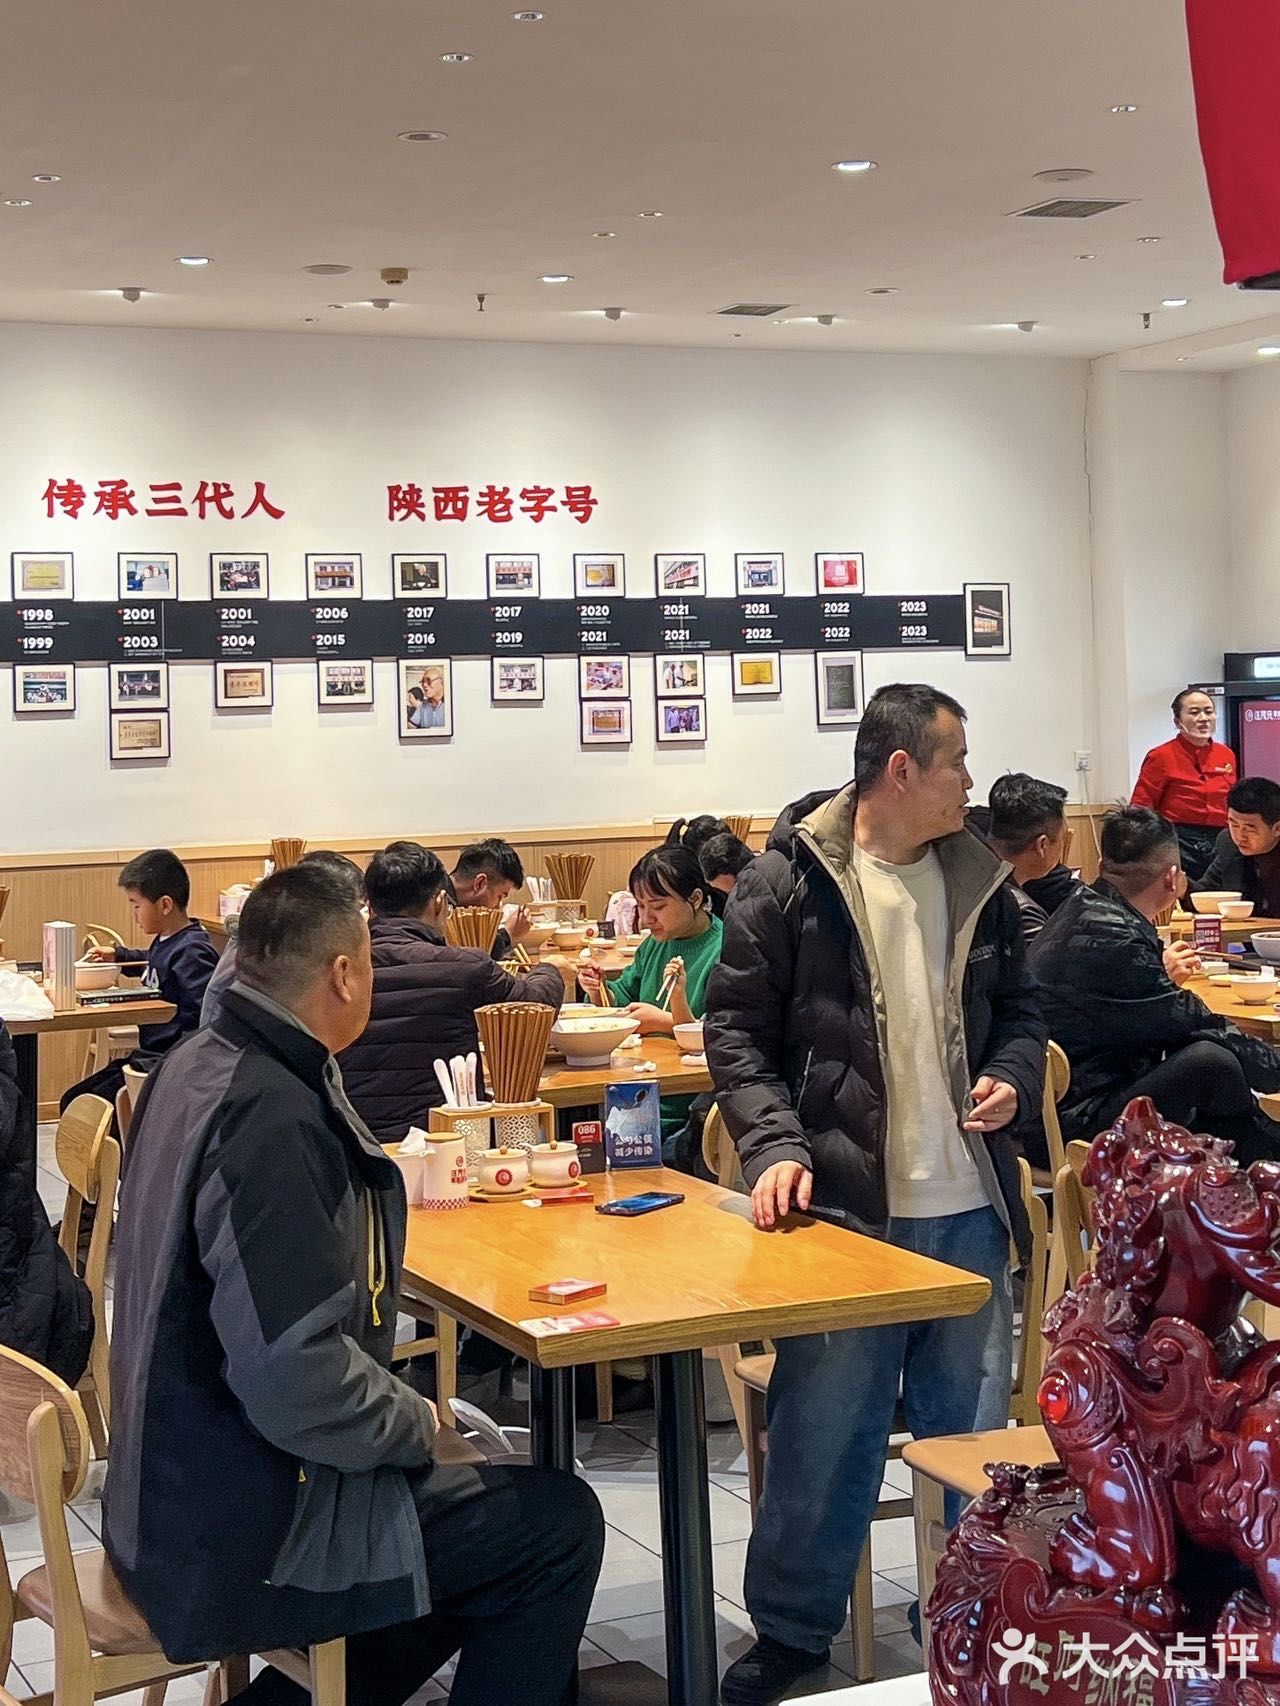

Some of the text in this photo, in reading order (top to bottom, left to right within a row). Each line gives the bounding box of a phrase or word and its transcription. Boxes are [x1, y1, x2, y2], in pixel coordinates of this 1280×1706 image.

[43, 478, 285, 520] 传承三代人
[387, 483, 598, 524] 陕西老字号
[406, 606, 434, 618] 2017
[494, 606, 522, 617] 2017
[580, 605, 610, 616] 2020
[663, 604, 689, 615] 2021
[744, 603, 770, 614] 2021
[823, 602, 850, 613] 2022
[900, 601, 927, 612] 2023
[22, 608, 54, 621] 1998
[122, 608, 155, 620] 2001
[221, 608, 252, 620] 2001
[315, 607, 348, 619] 2006
[581, 631, 607, 642] 2021
[664, 629, 690, 641] 2021
[745, 628, 772, 639] 2022
[824, 627, 851, 638] 2022
[901, 625, 928, 637] 2023
[22, 636, 54, 650] 1999
[122, 635, 159, 648] 2003
[221, 634, 256, 647] 2004
[315, 634, 346, 646] 2015
[407, 633, 436, 645] 2016
[495, 632, 523, 644] 2019
[577, 1124, 596, 1135] 086
[614, 1146, 654, 1157] 减少传染
